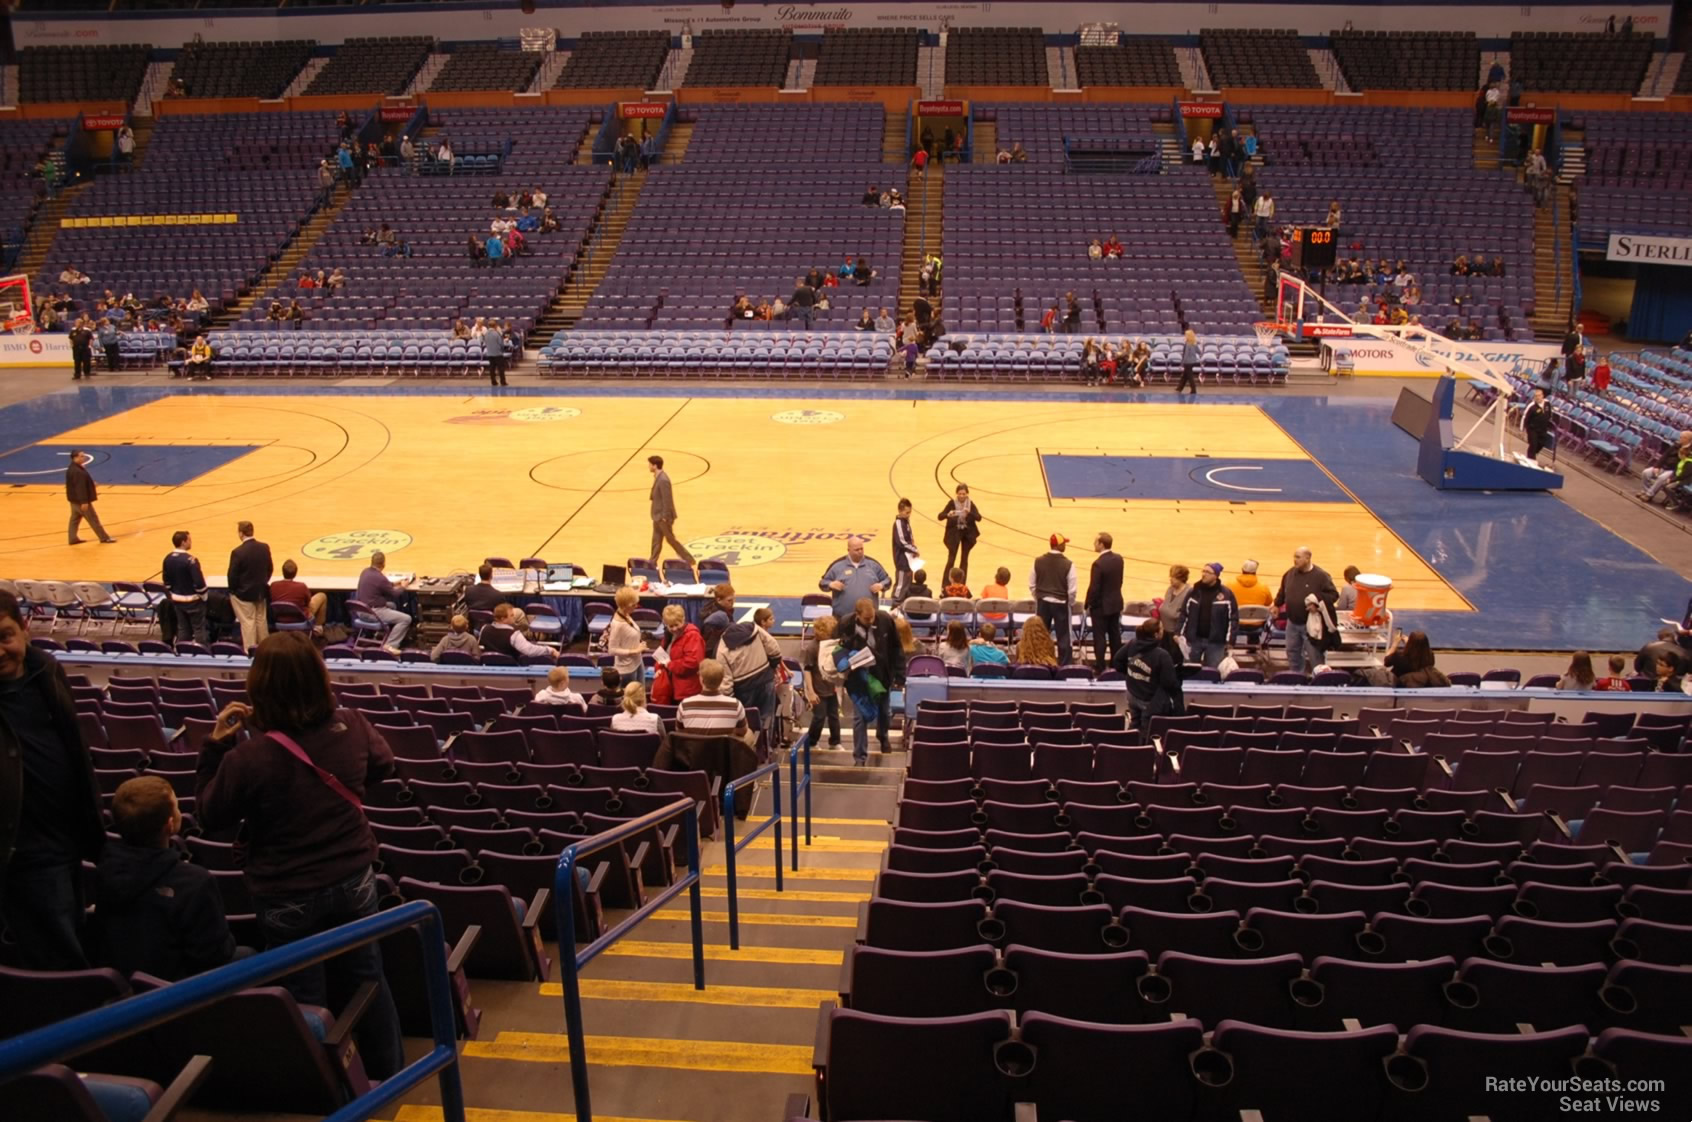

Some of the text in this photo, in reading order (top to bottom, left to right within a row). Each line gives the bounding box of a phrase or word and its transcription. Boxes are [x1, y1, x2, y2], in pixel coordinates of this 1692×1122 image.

[774, 5, 853, 21] Bommarito
[1616, 236, 1692, 260] STERLI
[3, 343, 73, 351] BMO Harri
[1350, 349, 1394, 359] MOTORS
[327, 545, 364, 559] 4
[709, 551, 741, 565] 4
